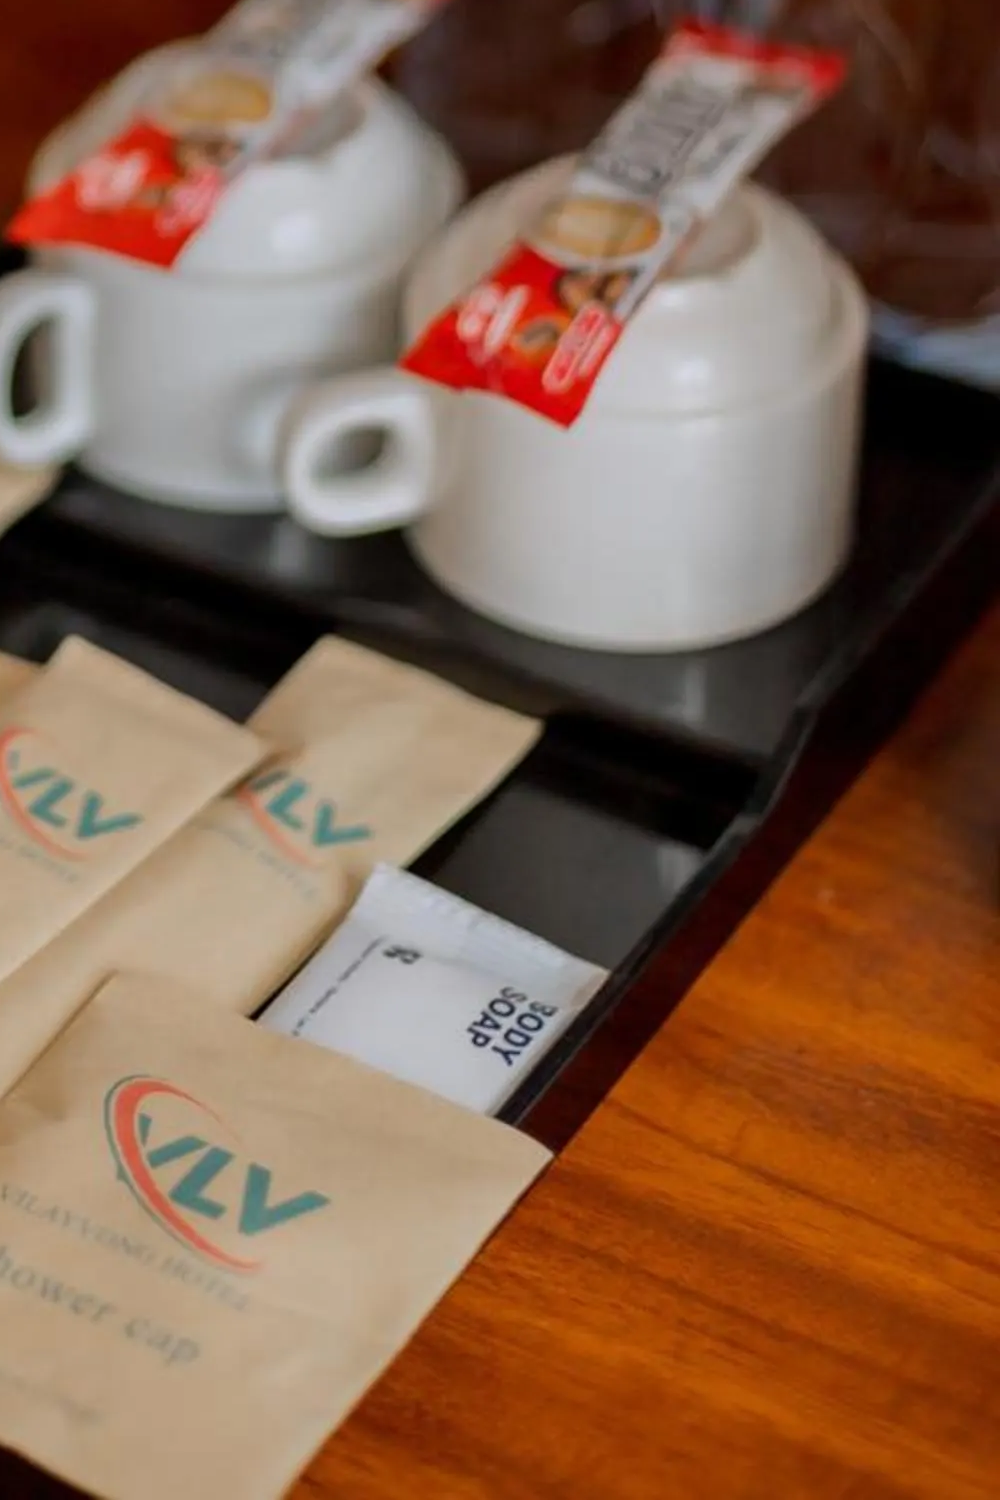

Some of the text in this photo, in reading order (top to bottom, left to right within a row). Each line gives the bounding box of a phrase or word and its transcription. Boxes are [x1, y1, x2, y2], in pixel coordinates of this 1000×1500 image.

[9, 749, 143, 839] VLV
[467, 986, 527, 1049] SOAP
[492, 1001, 558, 1066] BODY
[138, 1112, 331, 1236] VLV
[123, 1316, 202, 1368] cap
